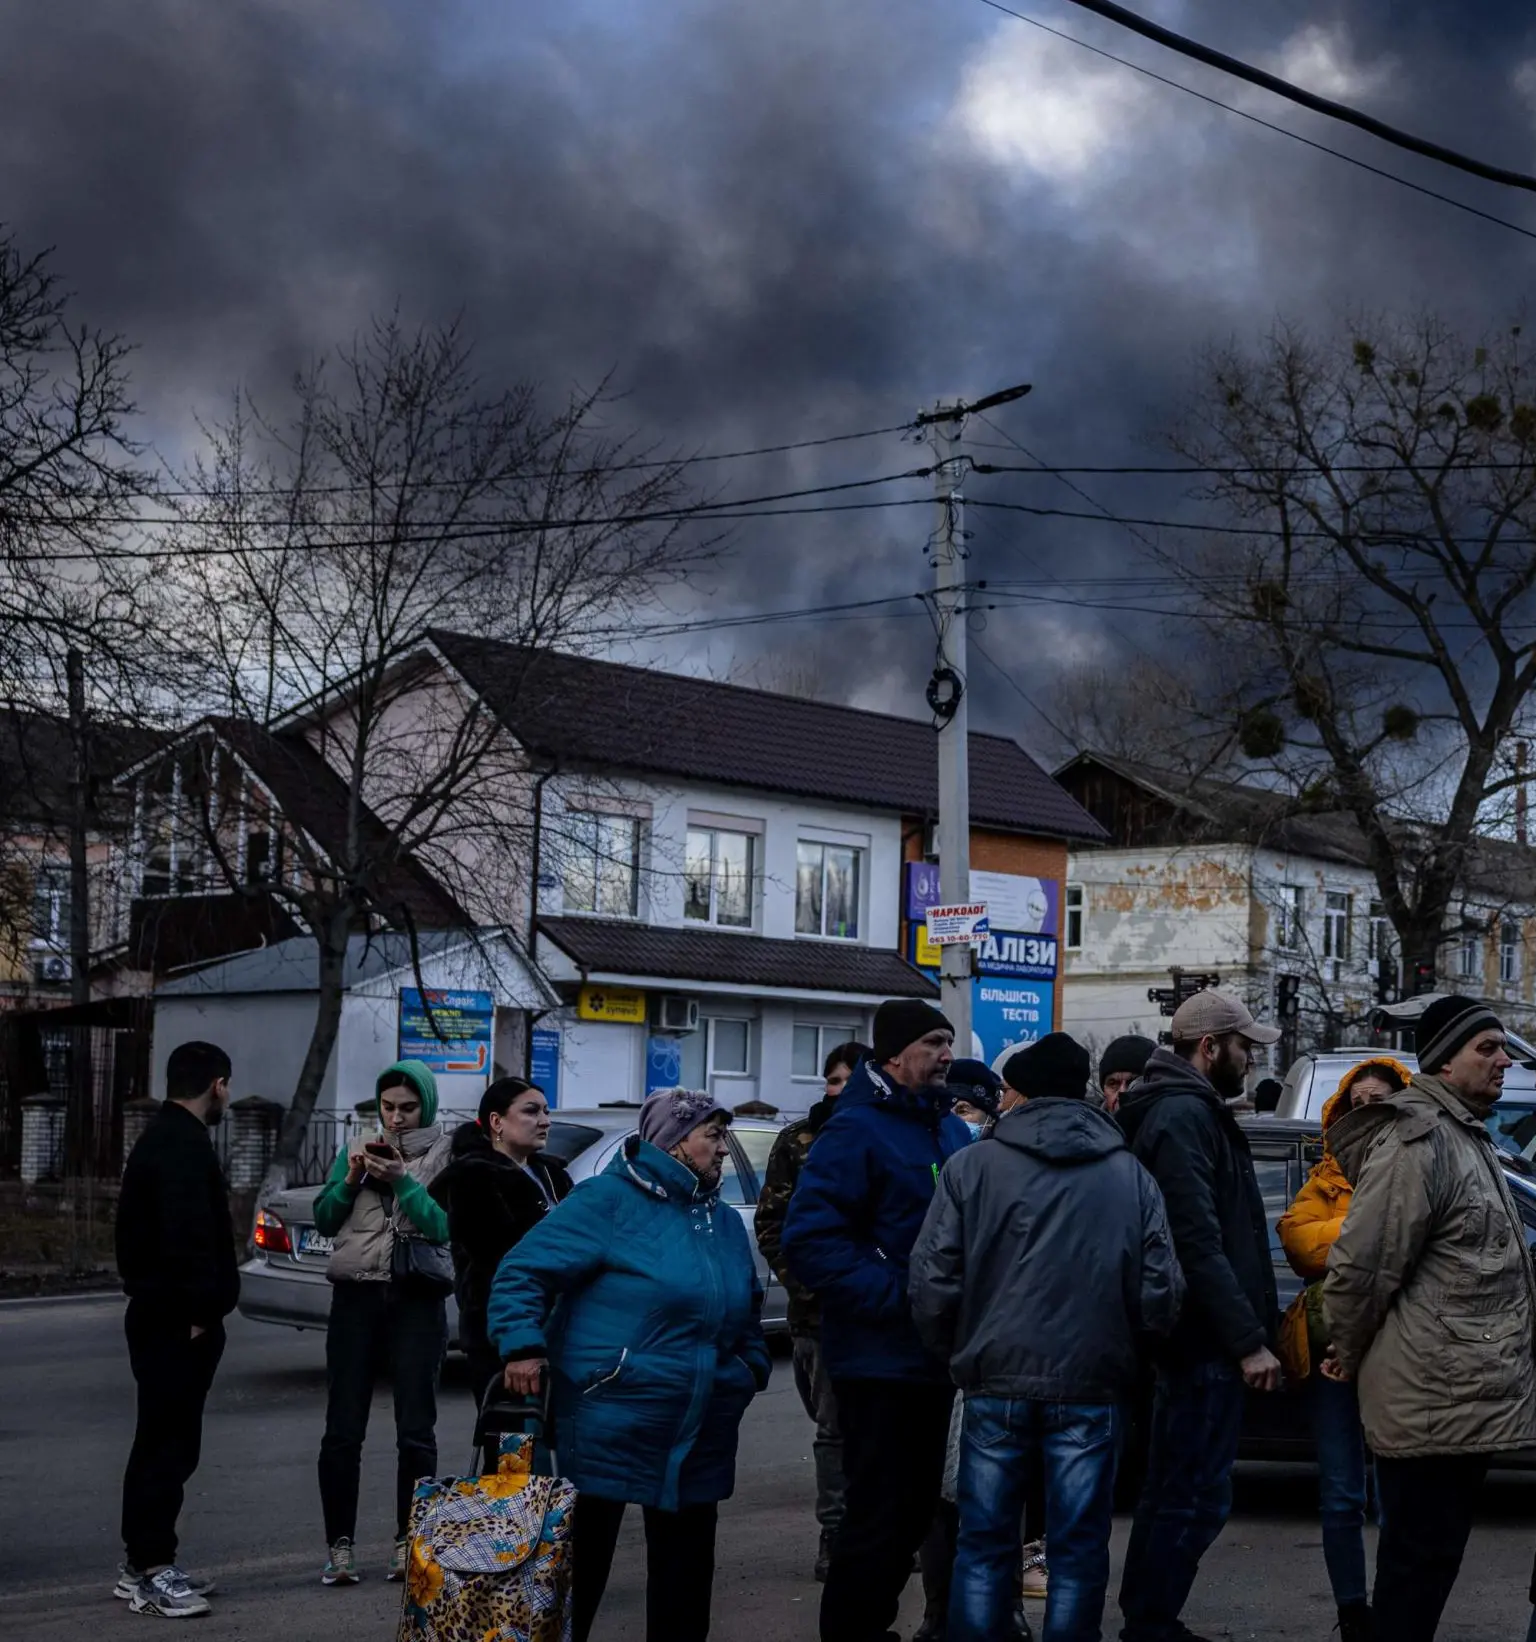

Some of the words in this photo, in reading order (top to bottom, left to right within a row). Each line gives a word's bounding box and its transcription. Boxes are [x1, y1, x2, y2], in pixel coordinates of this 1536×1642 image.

[933, 905, 985, 918] НАРКОЛОГ
[980, 987, 1040, 1005] БІЛЬШІСТЬ
[1001, 1007, 1040, 1022] ТЕСТІВ
